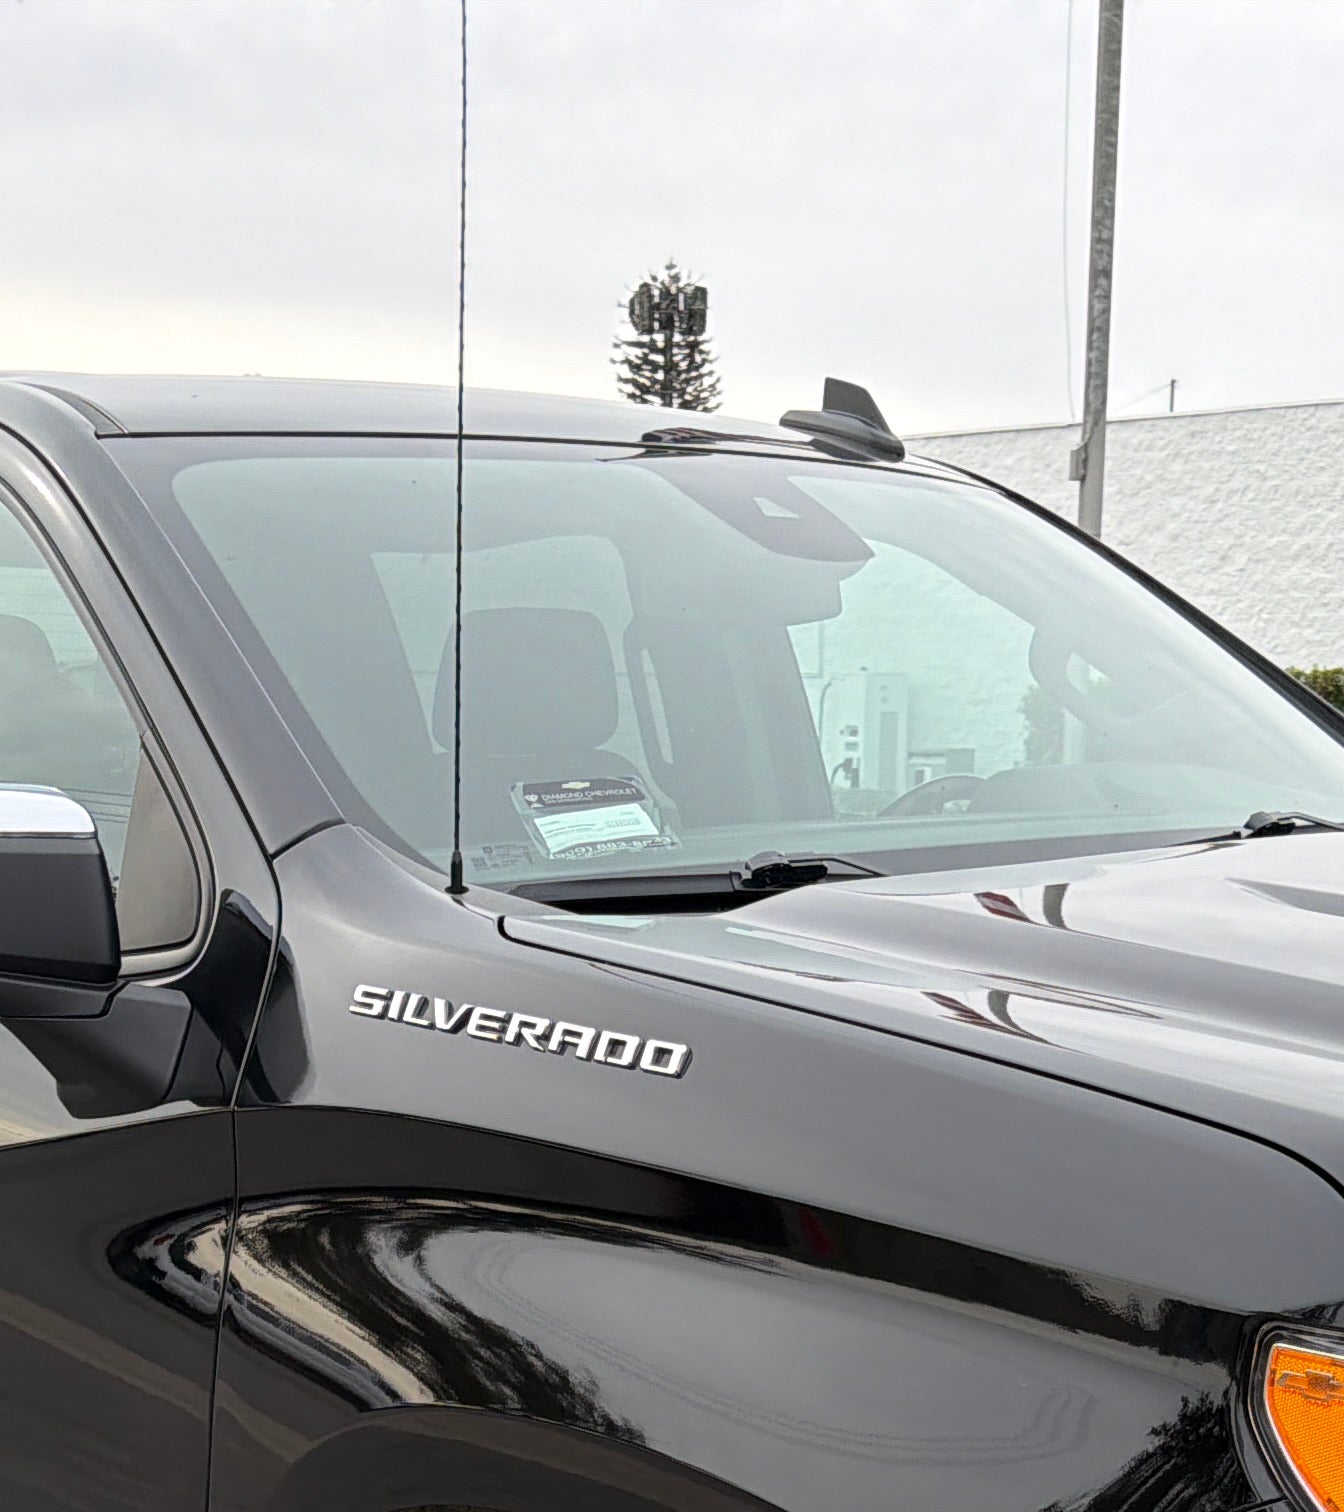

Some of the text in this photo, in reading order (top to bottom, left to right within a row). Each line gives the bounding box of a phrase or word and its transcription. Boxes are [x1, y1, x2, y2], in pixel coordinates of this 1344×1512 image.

[541, 791, 584, 802] DIAMOND
[584, 787, 638, 798] CHEVROLET
[349, 983, 694, 1079] SILVERADO
